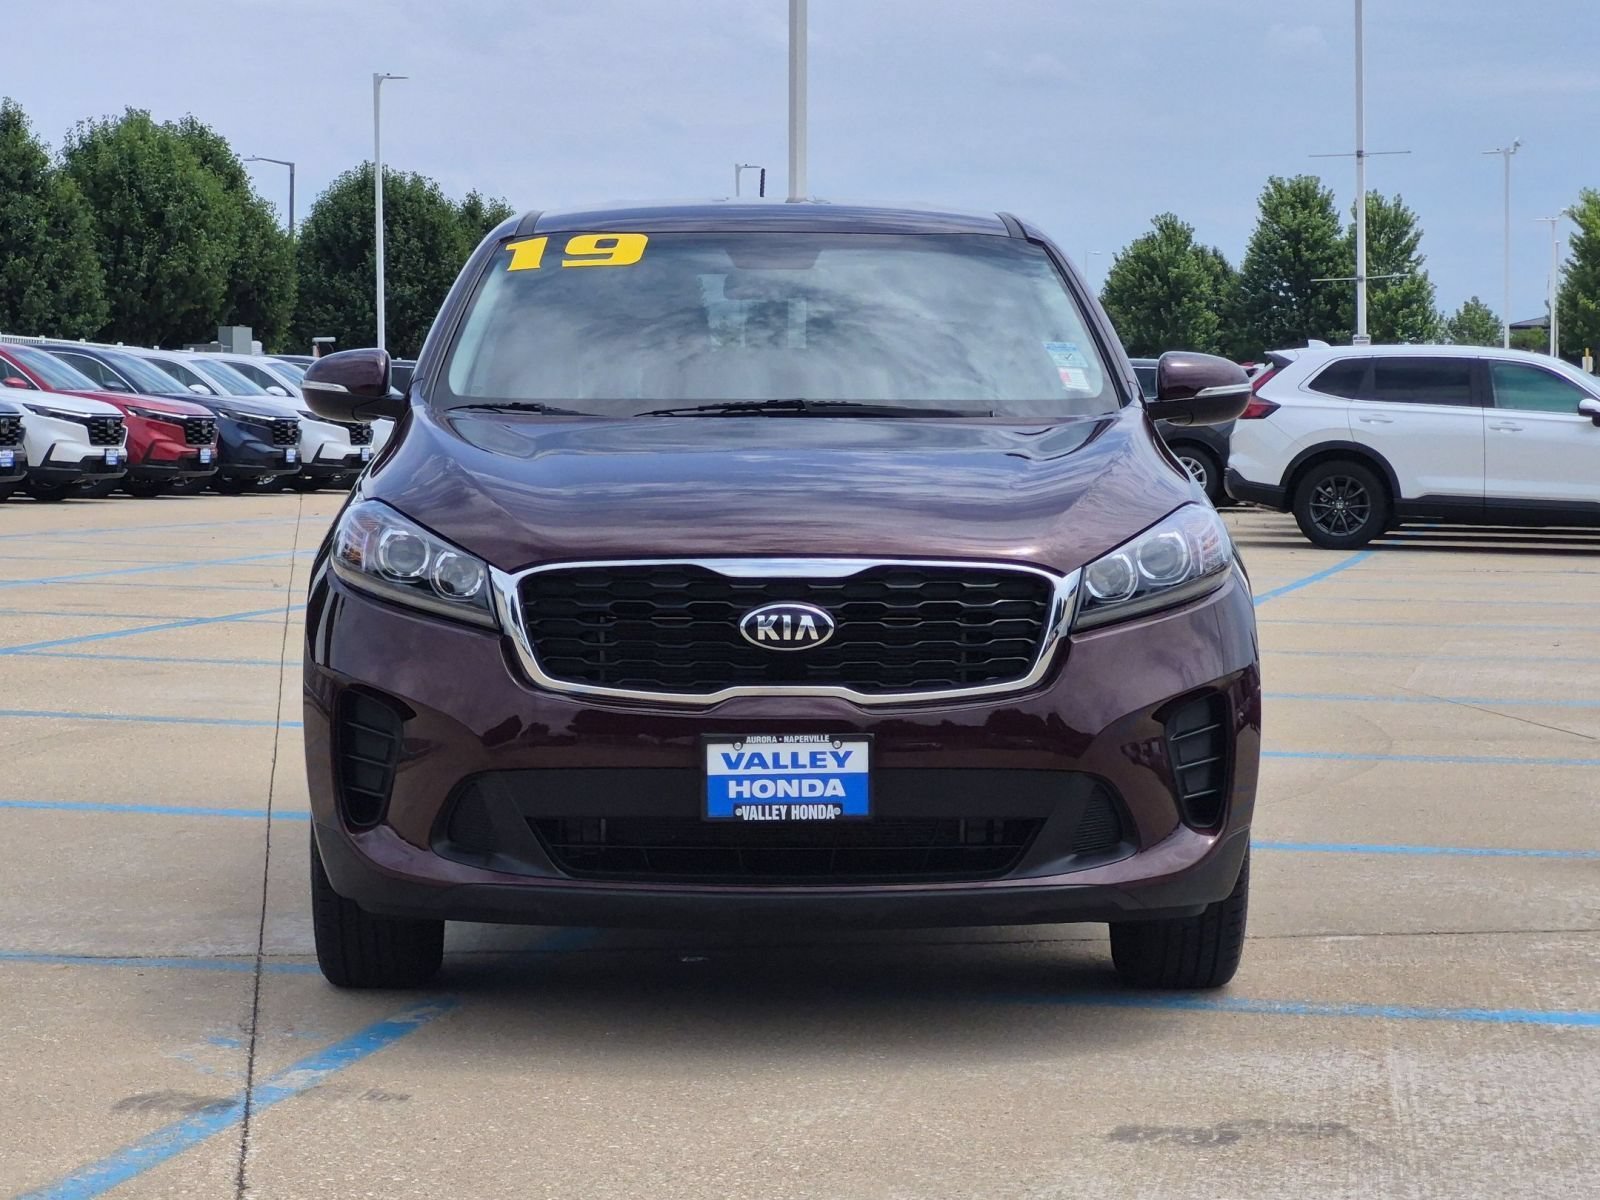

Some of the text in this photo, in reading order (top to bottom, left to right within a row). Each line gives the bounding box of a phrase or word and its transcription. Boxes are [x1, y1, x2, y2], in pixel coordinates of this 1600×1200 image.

[505, 233, 649, 271] 19
[756, 614, 819, 640] KIA
[746, 734, 829, 743] AURORA NAPERVILLE
[720, 750, 853, 770] VALLEY
[728, 778, 846, 798] HONDA
[742, 804, 835, 821] VALLEY HONDA
